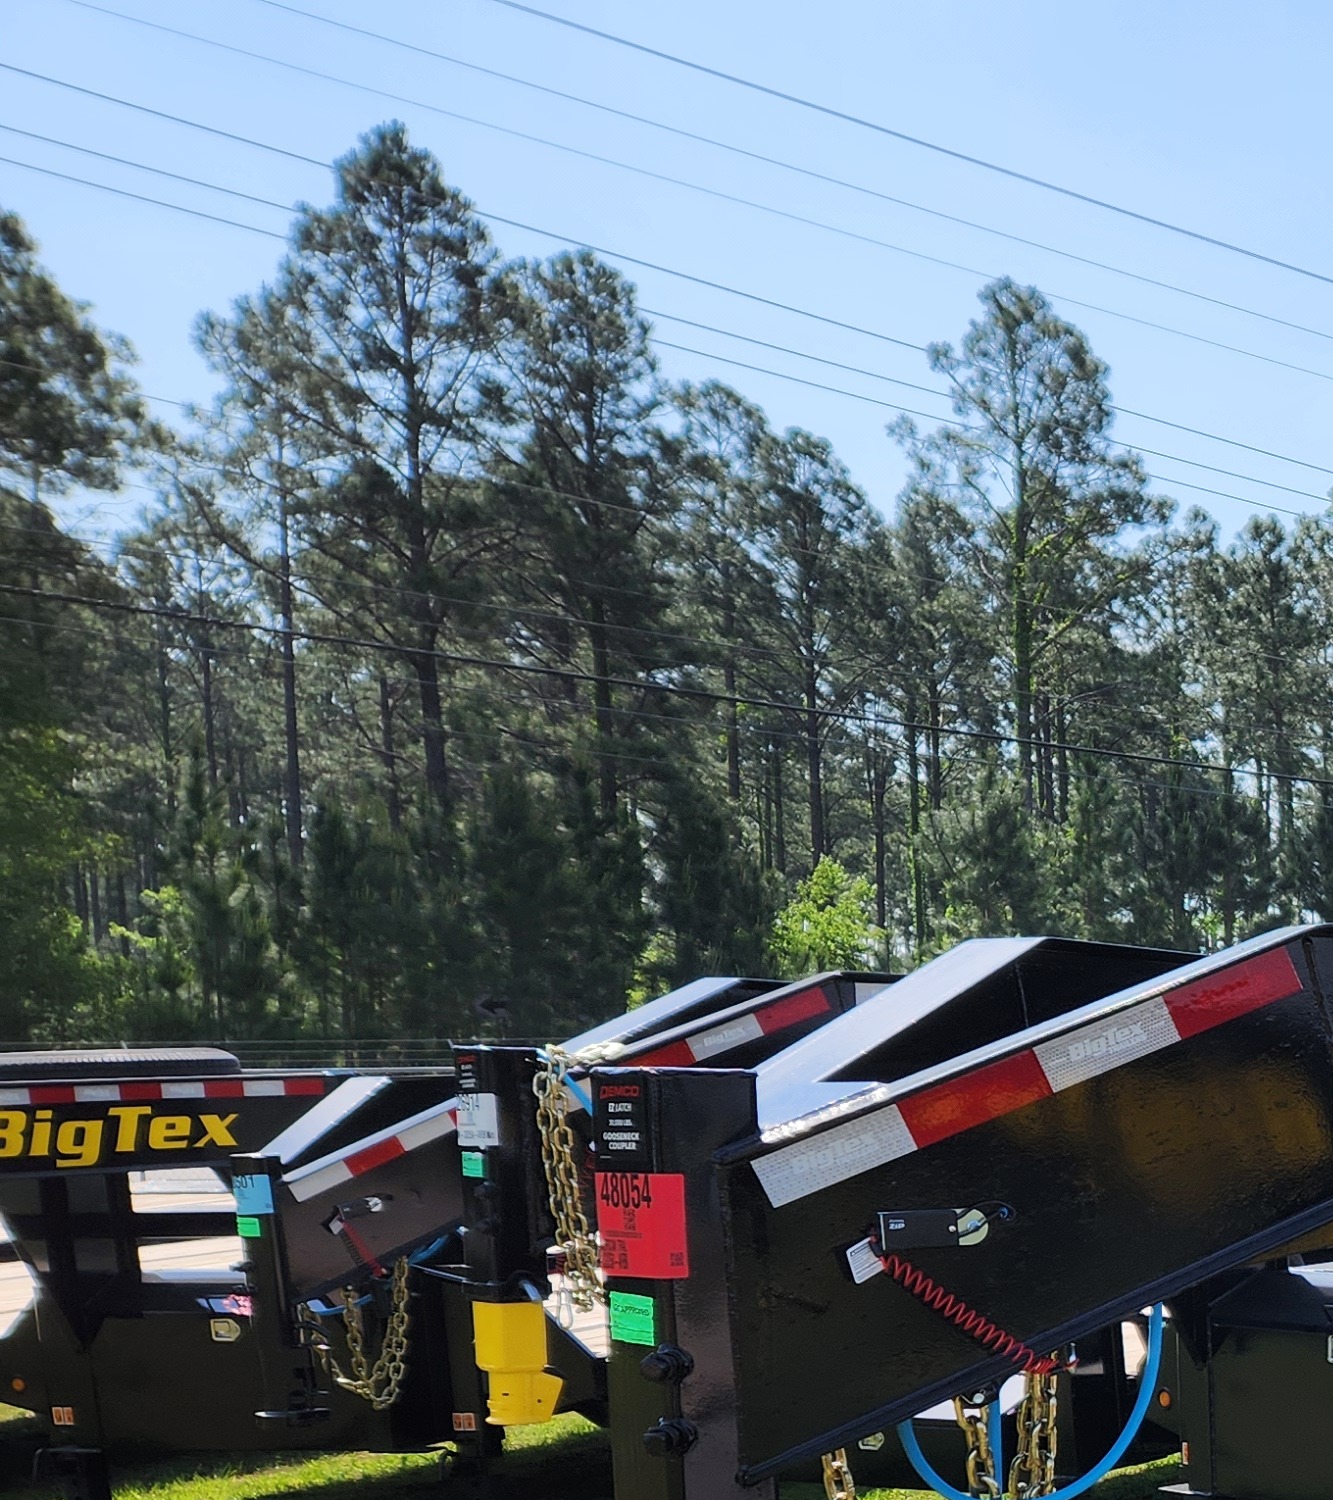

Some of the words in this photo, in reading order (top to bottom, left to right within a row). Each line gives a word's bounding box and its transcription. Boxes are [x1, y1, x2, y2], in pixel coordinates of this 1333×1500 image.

[1067, 1021, 1145, 1063] BigTex
[600, 1085, 640, 1099] DEMCO
[602, 1131, 640, 1141] GOOSENECK
[608, 1141, 637, 1150] COUPLER
[600, 1172, 652, 1209] 48054
